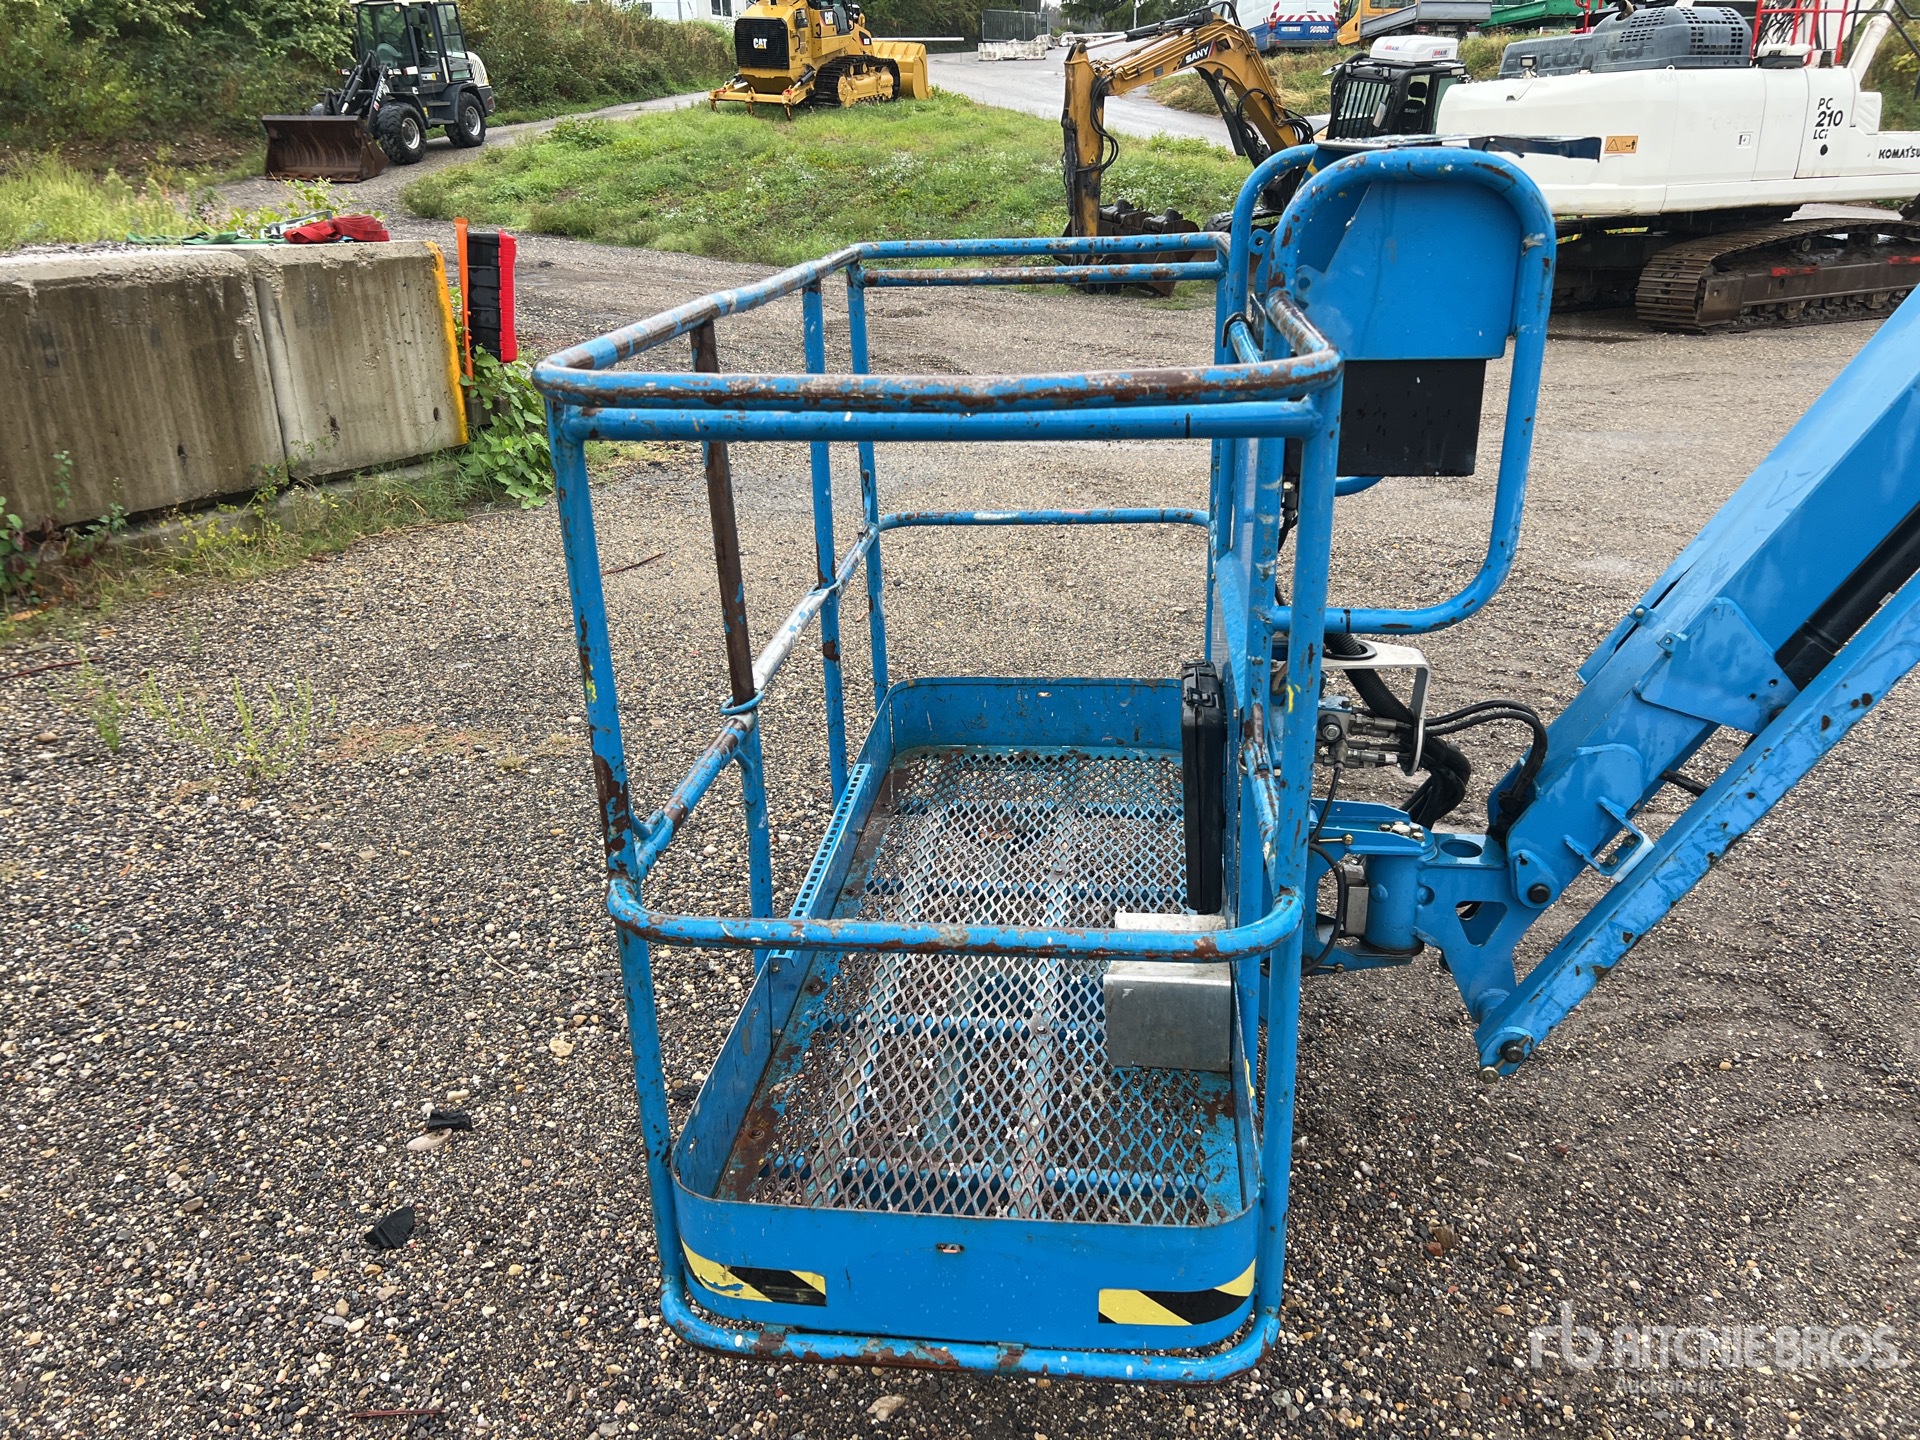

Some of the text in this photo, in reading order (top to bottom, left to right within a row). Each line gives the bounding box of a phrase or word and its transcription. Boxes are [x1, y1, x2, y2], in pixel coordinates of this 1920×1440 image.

[824, 11, 834, 24] CAT
[753, 38, 767, 49] CAT
[1185, 46, 1209, 63] SANY
[1817, 97, 1834, 110] PC
[1815, 110, 1844, 128] 210
